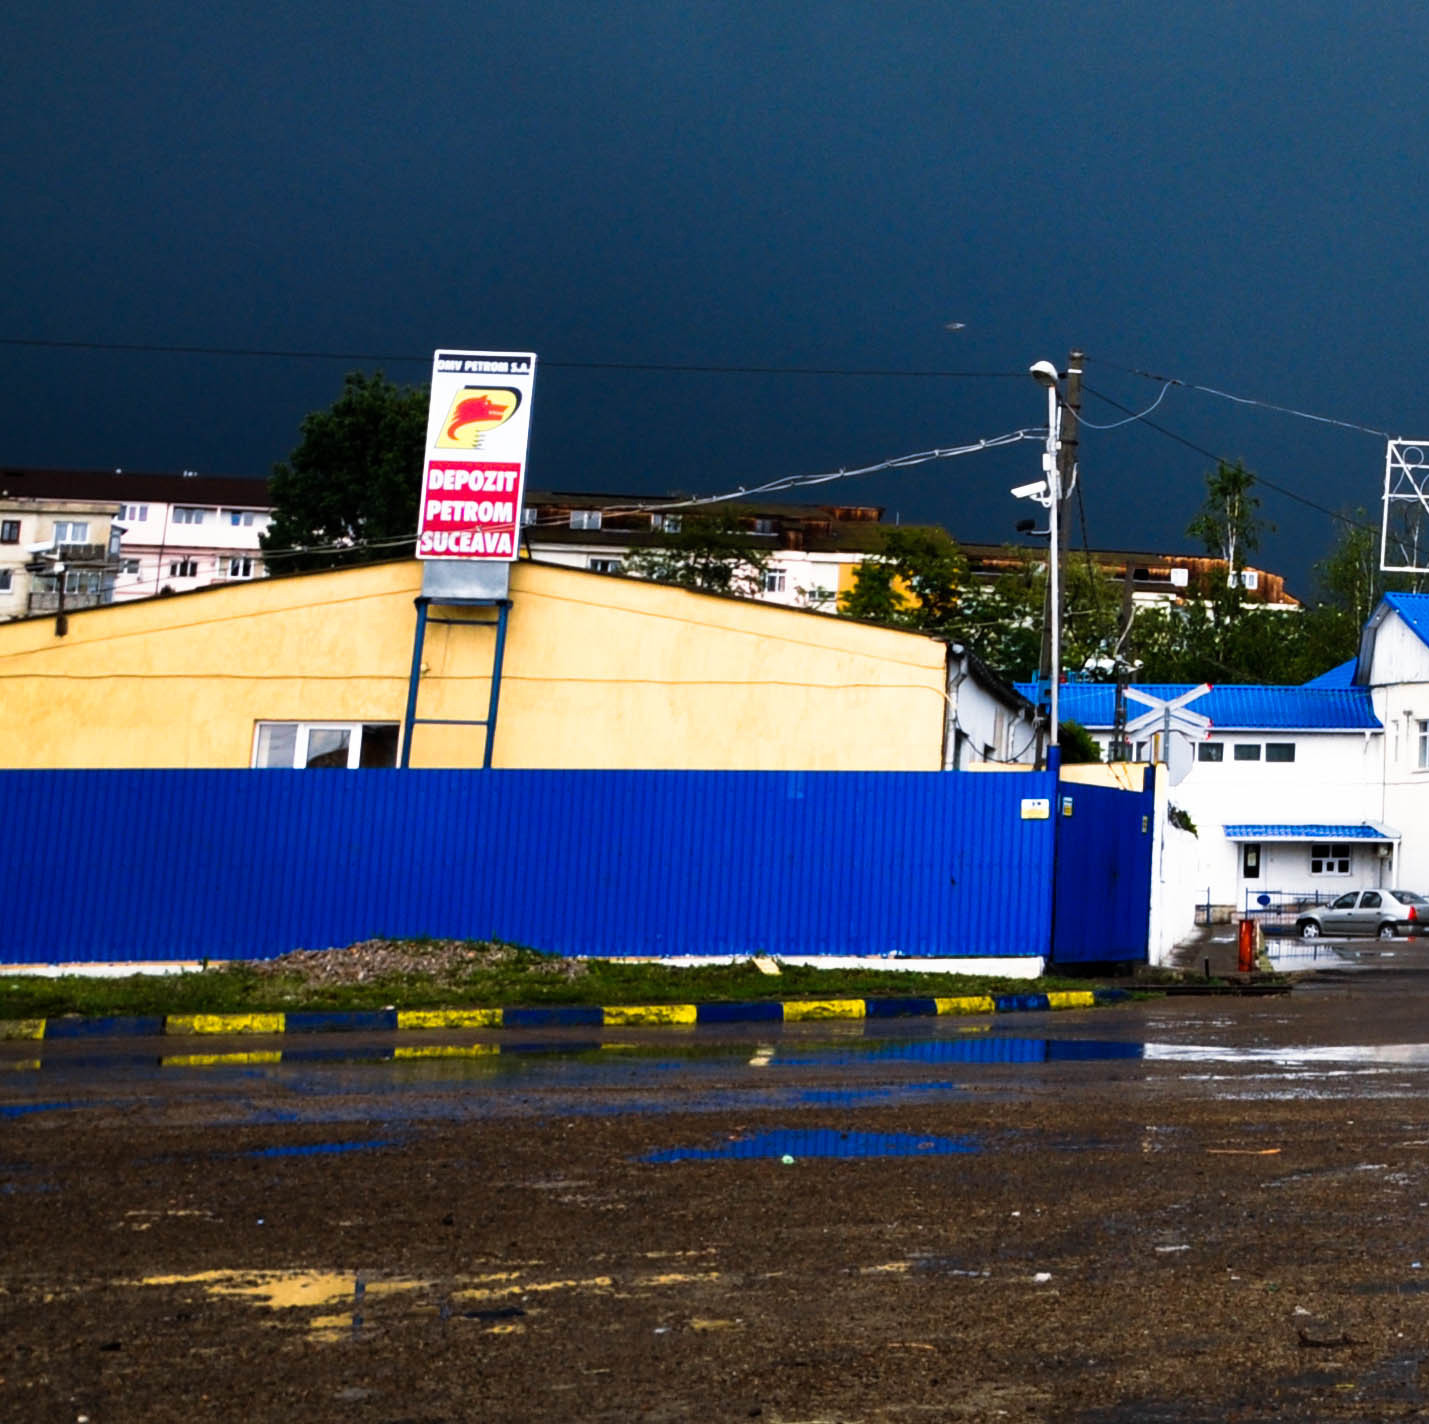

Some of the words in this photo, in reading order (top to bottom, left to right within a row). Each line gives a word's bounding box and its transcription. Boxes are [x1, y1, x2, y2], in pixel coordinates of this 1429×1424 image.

[438, 360, 461, 371] OMV
[464, 361, 509, 373] PETROM
[429, 470, 517, 491] DEPOZIT
[426, 500, 513, 523] PETROM
[420, 531, 511, 553] SUCEAVA
